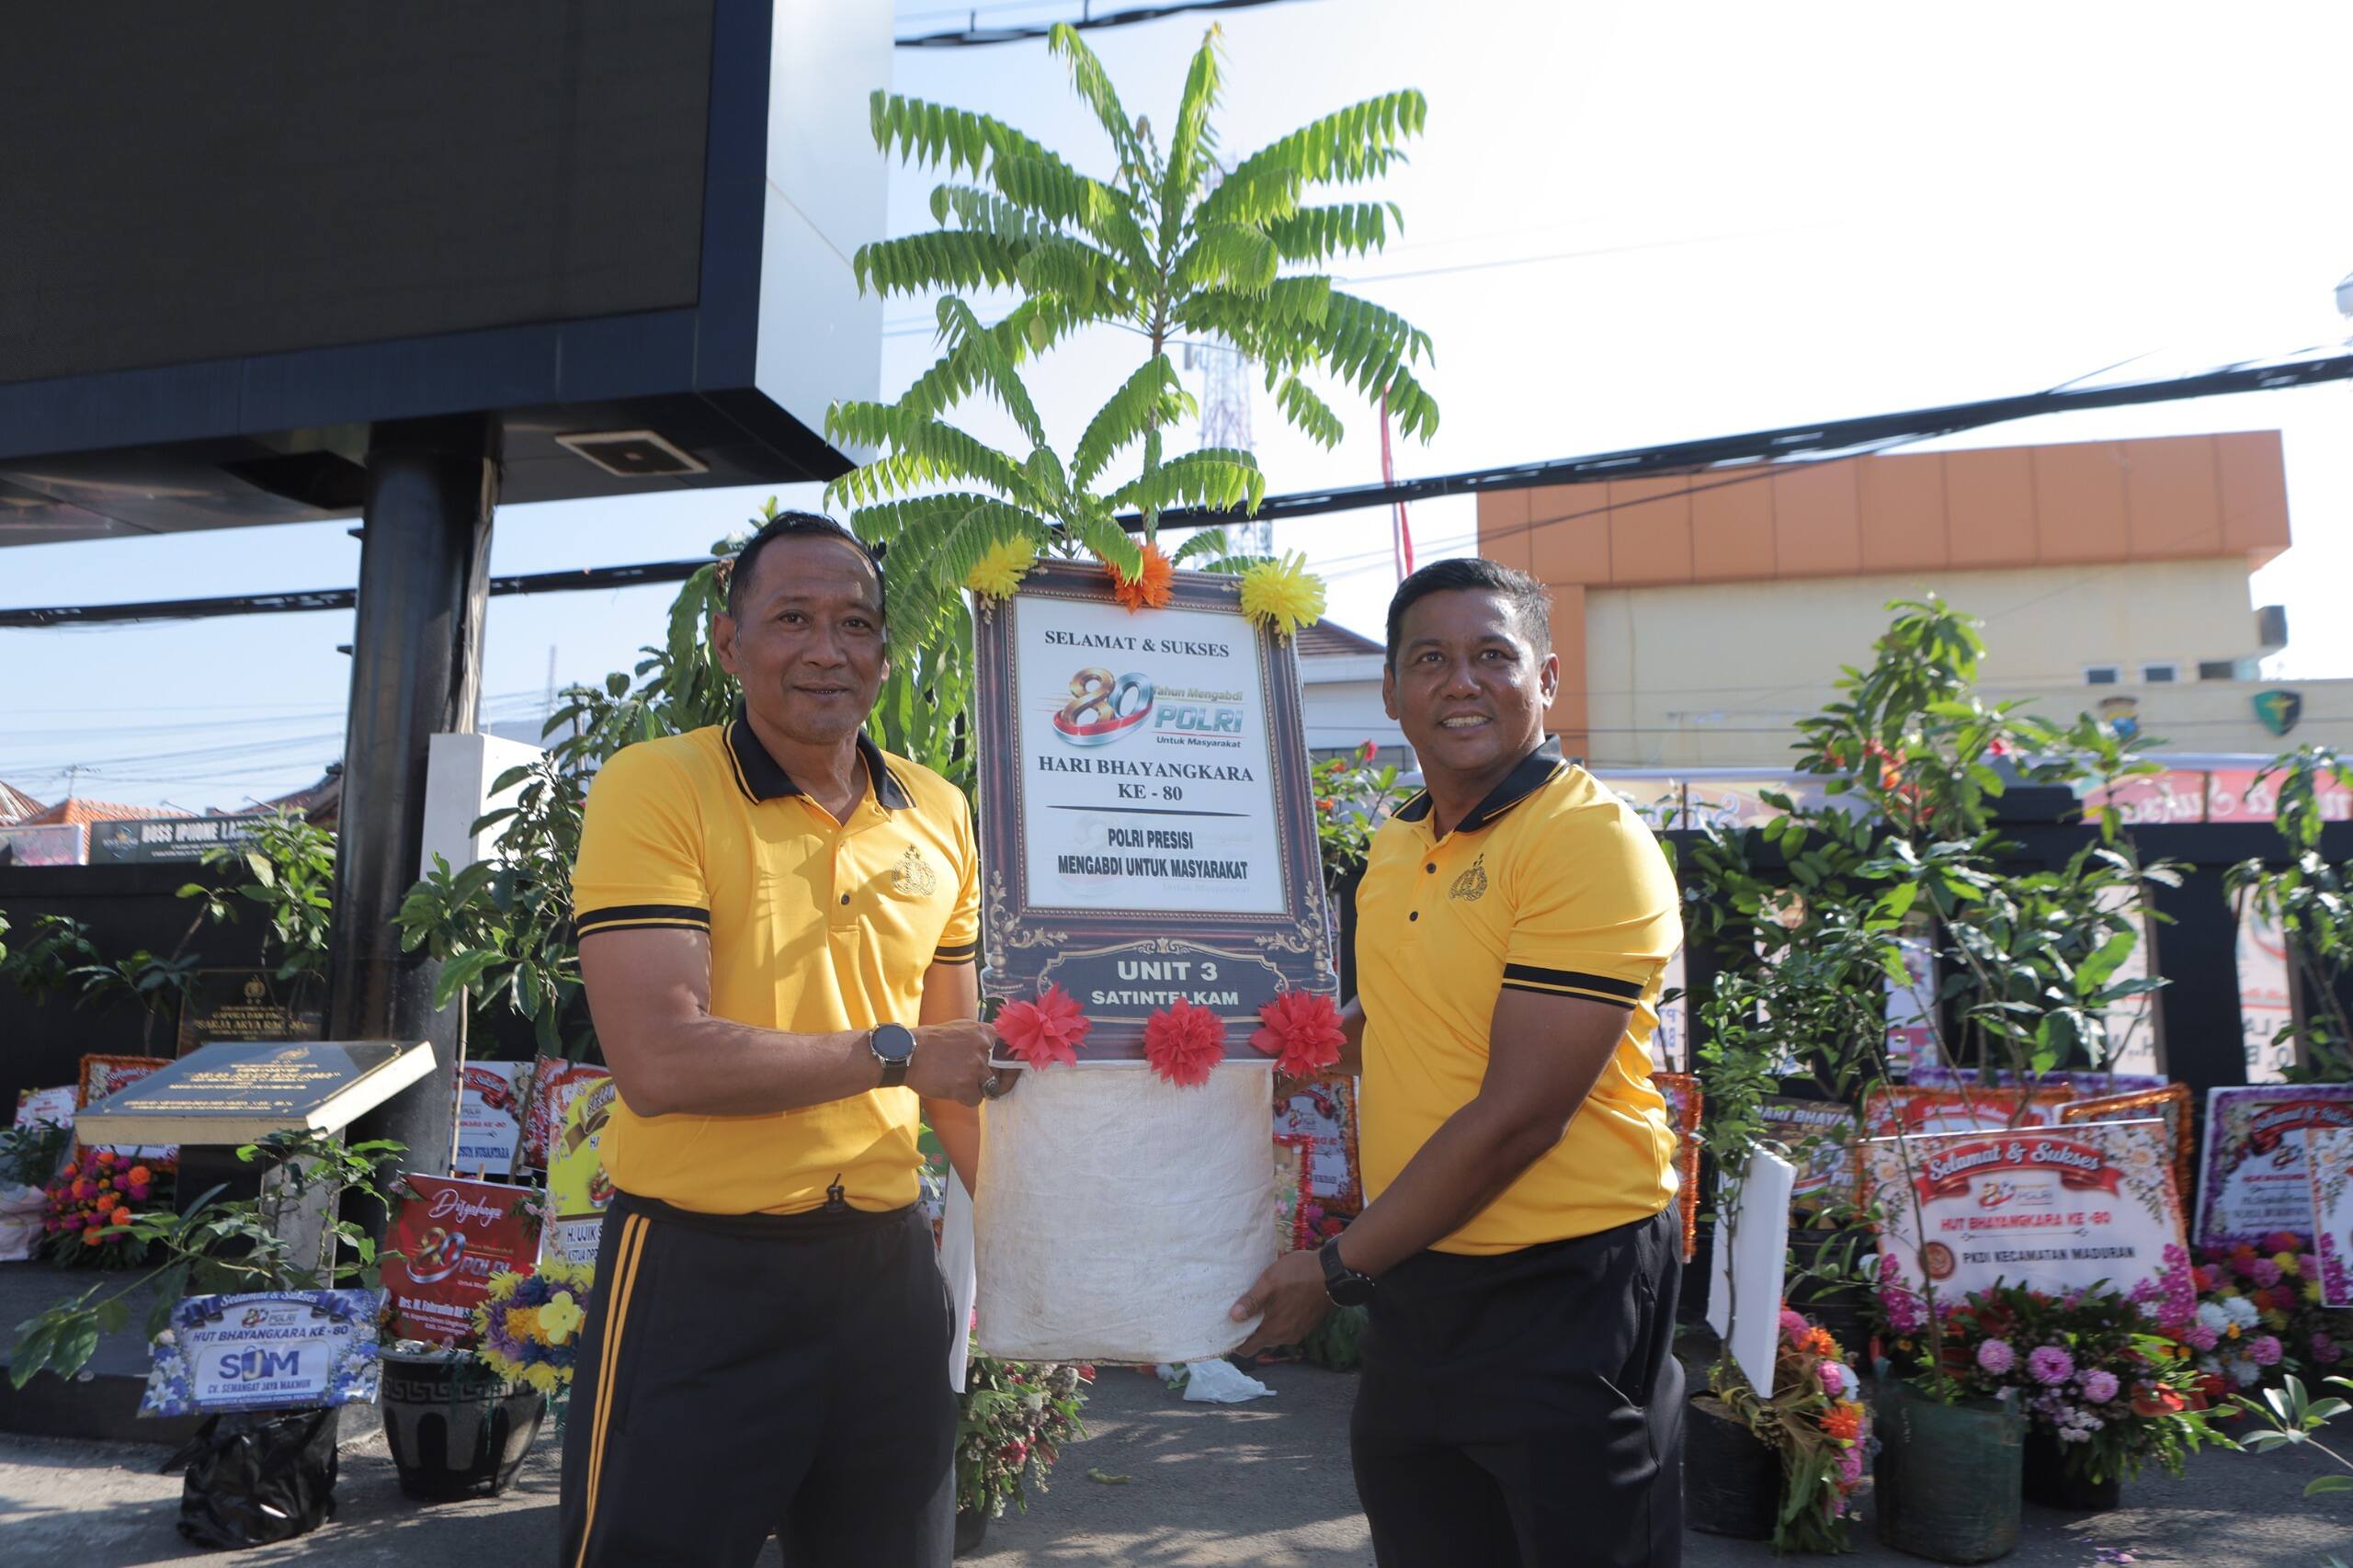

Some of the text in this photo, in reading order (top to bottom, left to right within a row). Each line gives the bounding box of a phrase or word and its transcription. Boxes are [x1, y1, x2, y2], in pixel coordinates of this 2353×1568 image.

[1044, 630, 1230, 658] SELAMAT & SUKSES
[1188, 687, 1244, 702] Mengabdi
[1154, 703, 1244, 734] POLRI
[1156, 735, 1242, 749] Untuk Masyarakat
[1038, 756, 1255, 782] HARI BHAYANGKARA
[1118, 783, 1147, 801] KE
[1163, 786, 1183, 801] 80
[1108, 827, 1144, 848] POLRI
[1146, 831, 1194, 850] PRESISI
[1057, 855, 1248, 881] MENGABDI UNTUK MASYARAKAT
[1117, 960, 1219, 982] UNIT 3
[1929, 1142, 2099, 1181] Selamat & Sukses
[1940, 1217, 1965, 1232] HUT
[1969, 1213, 2063, 1230] BHAYANGKARA
[2067, 1211, 2086, 1224] KE
[1994, 1248, 2067, 1264] KECAMATAN
[2071, 1246, 2136, 1261] MADURAN
[192, 1331, 217, 1343] HUT
[218, 1327, 307, 1342] BHAYANGKARA
[218, 1346, 300, 1382] SJM
